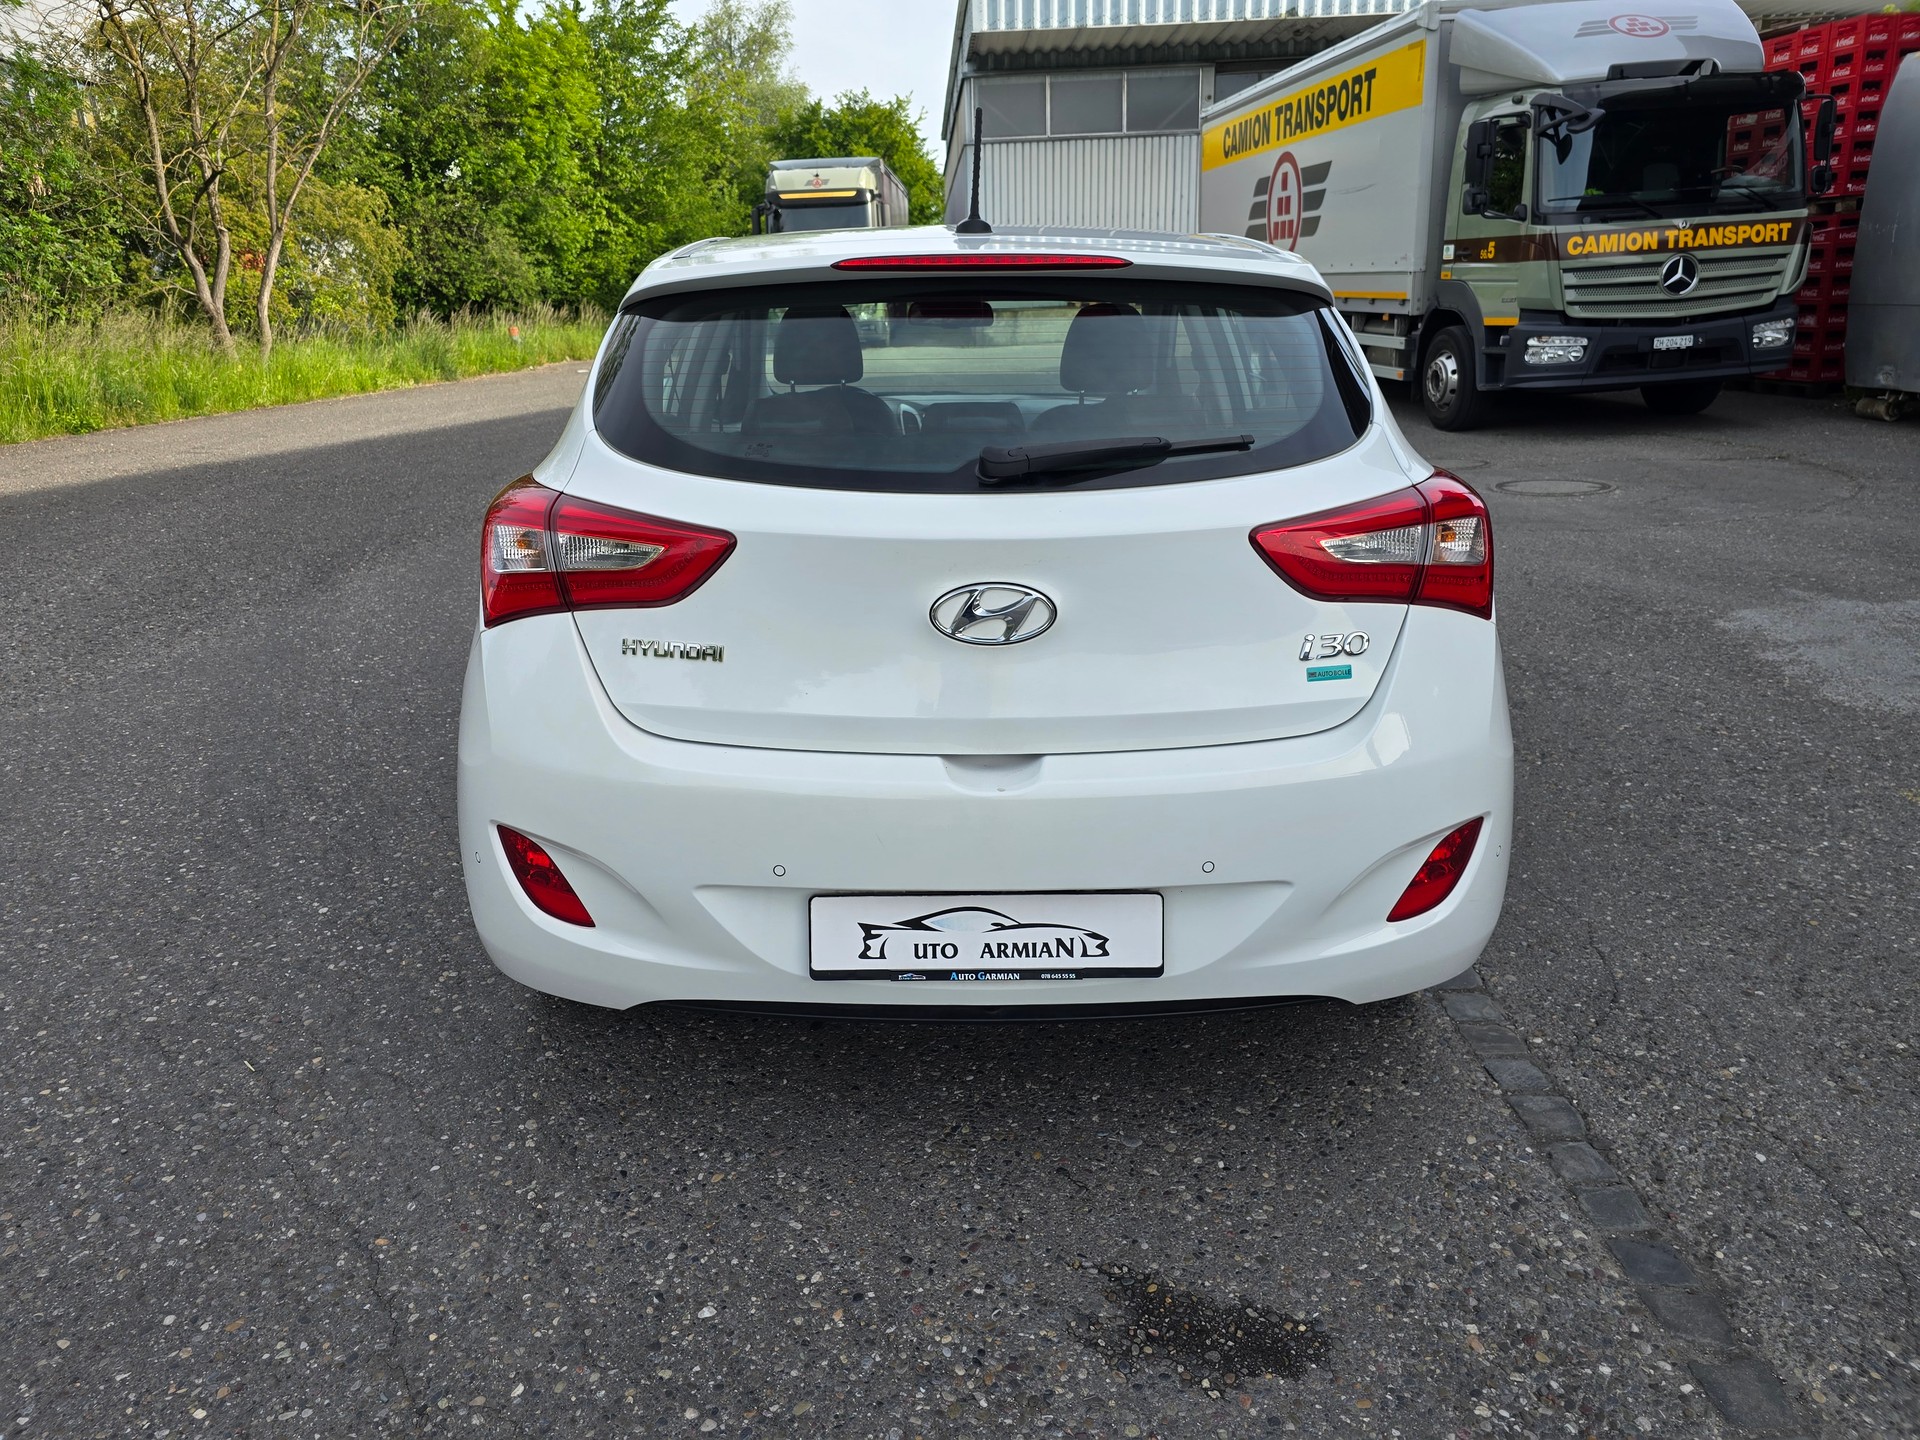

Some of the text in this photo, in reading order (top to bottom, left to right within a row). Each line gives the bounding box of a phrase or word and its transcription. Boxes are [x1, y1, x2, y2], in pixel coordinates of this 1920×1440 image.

[1223, 67, 1377, 159] CAMION TRANSPORT
[1567, 222, 1792, 255] CAMION TRANSPORT
[622, 638, 724, 662] HYUNDAI
[1299, 631, 1370, 661] i30
[980, 937, 1075, 959] ARMIAN
[950, 971, 1020, 981] AUTO GARMIAN
